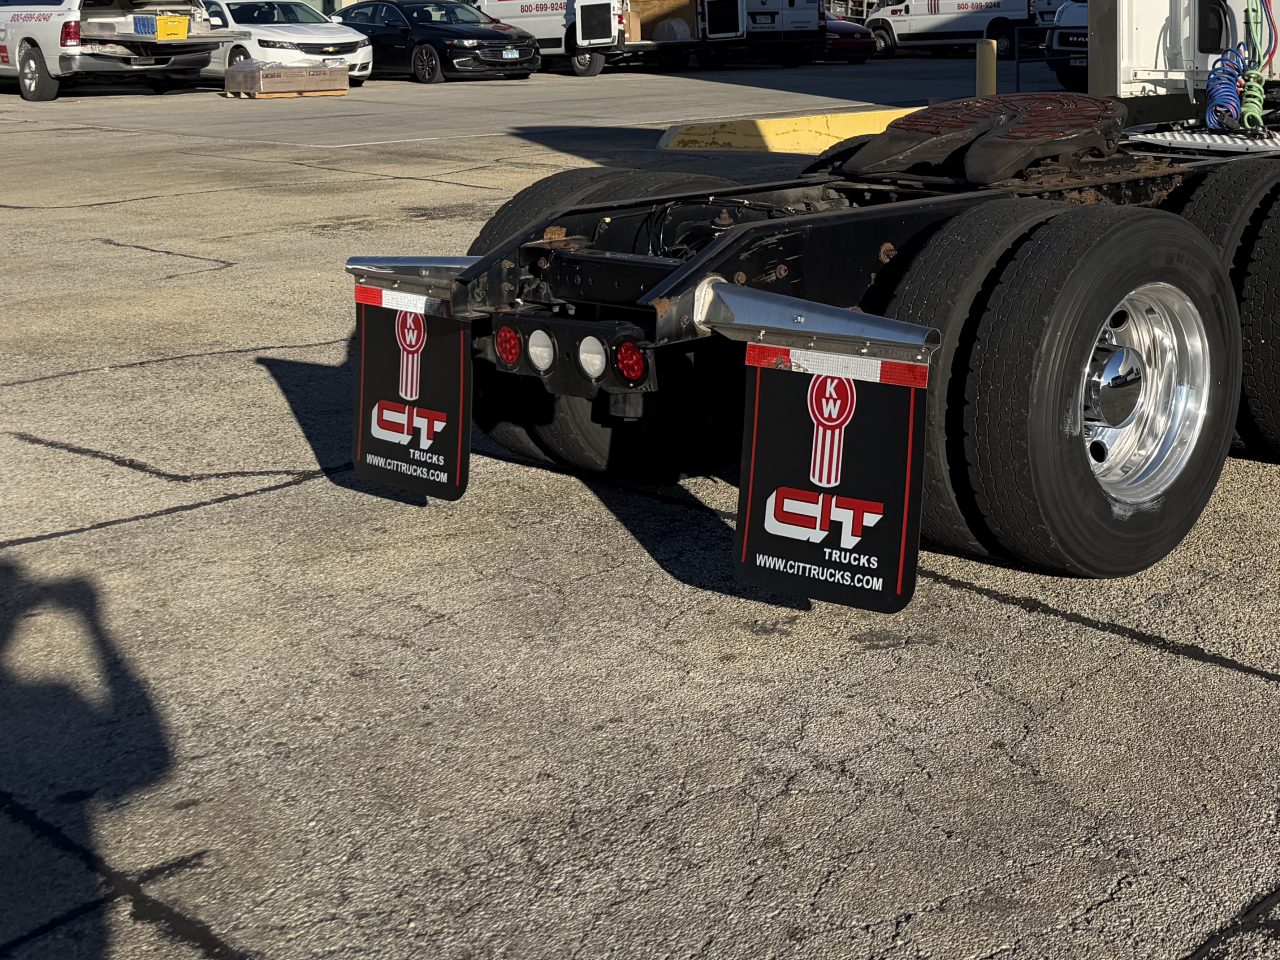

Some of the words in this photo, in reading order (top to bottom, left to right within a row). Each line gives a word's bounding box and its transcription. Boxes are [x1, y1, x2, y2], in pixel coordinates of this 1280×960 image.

[520, 2, 567, 13] 800-699-9248
[957, 2, 1000, 10] 800-699-9248
[371, 400, 447, 450] CIT
[366, 453, 448, 483] WWW.CITTRUCKS.COM
[409, 448, 445, 465] TRUCKS
[764, 487, 884, 550] CIT
[823, 548, 878, 569] TRUCKS
[756, 553, 883, 591] WWW.CITTRUCKS.COM
